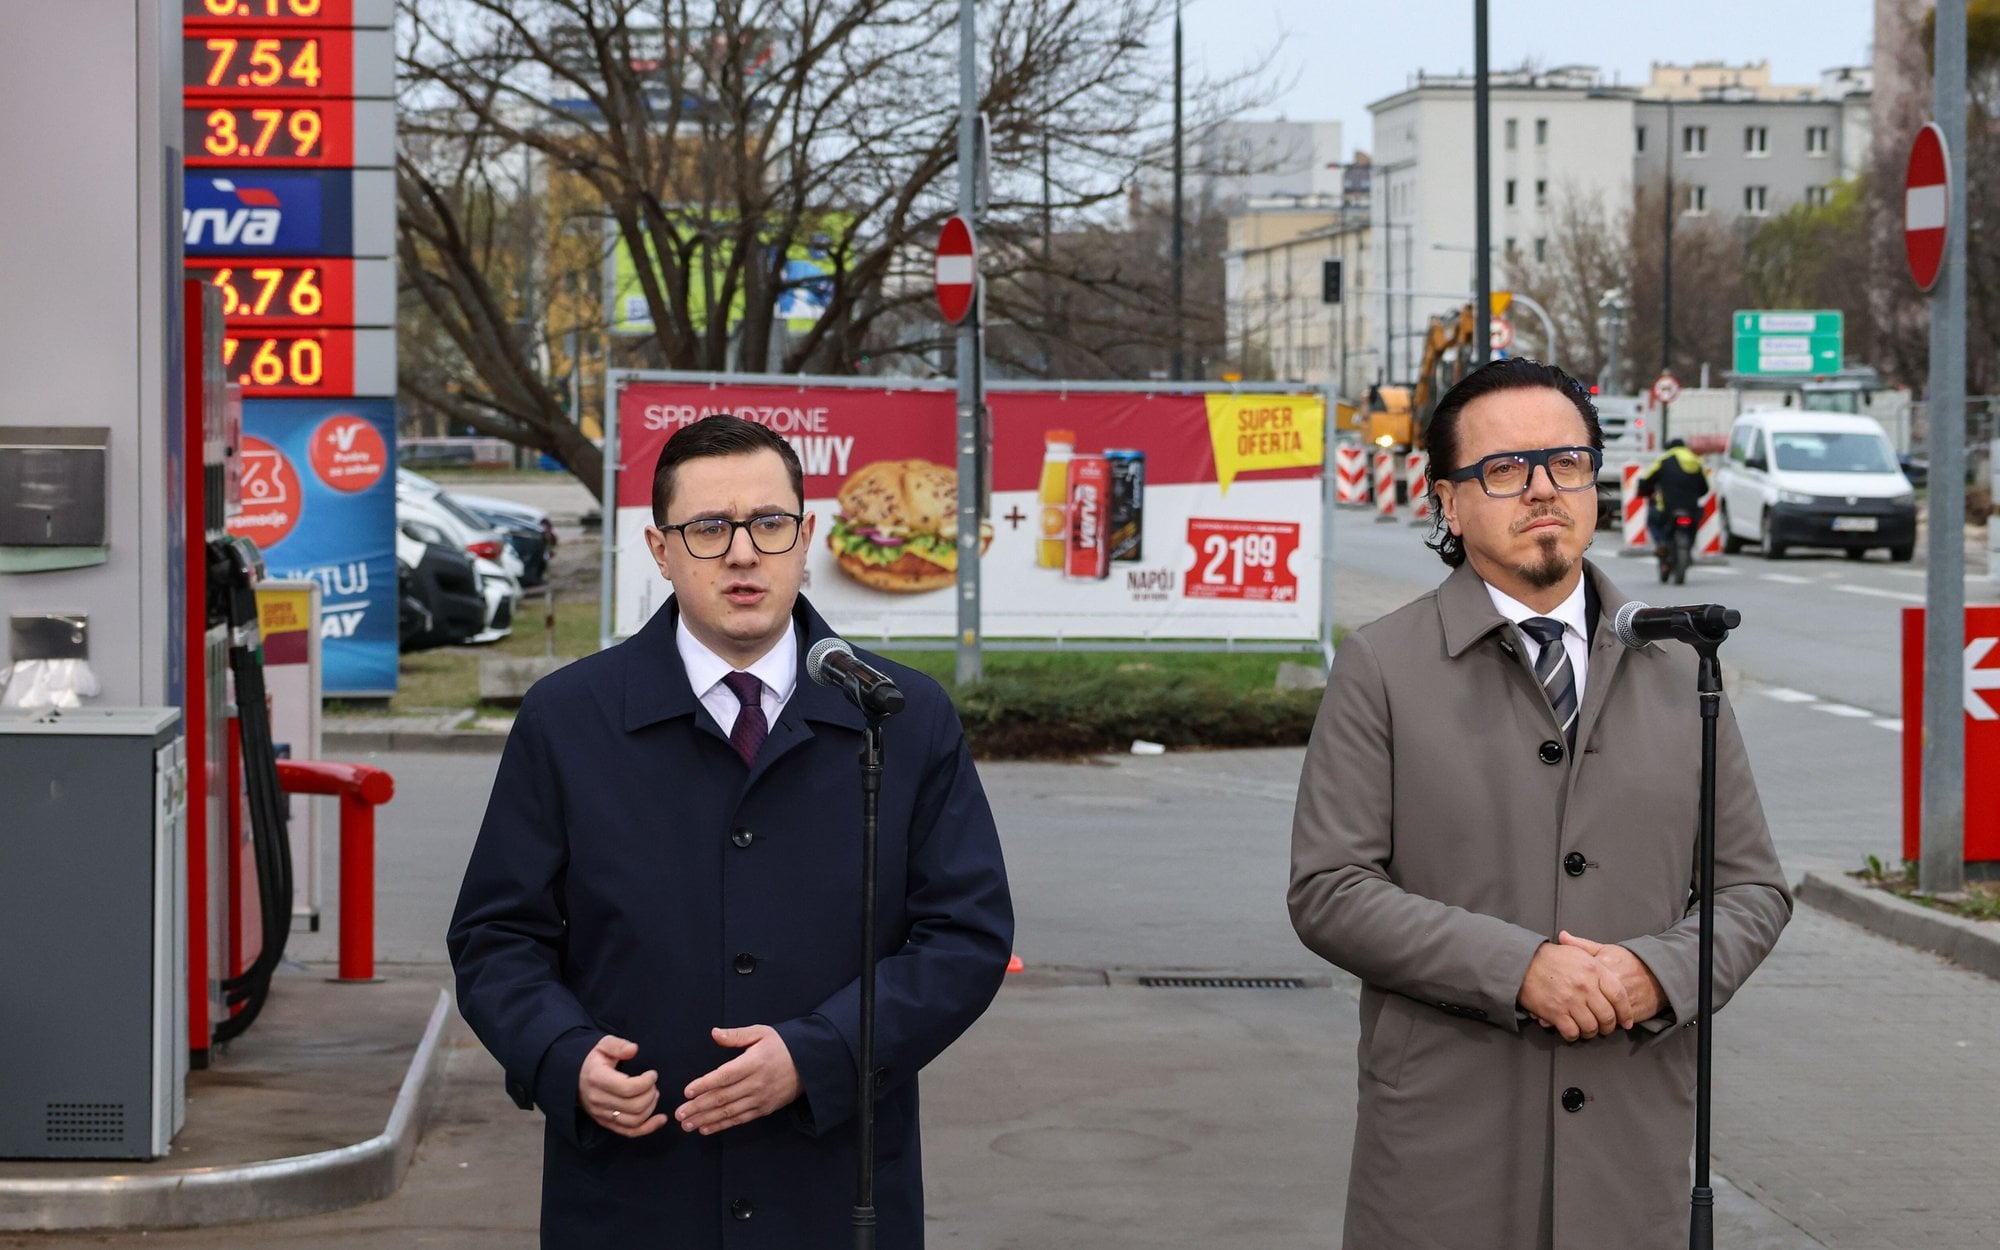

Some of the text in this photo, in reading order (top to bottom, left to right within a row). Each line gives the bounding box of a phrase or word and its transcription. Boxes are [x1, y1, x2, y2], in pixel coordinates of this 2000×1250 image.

[205, 39, 321, 86] 7.54
[205, 109, 321, 156] 3.79
[184, 208, 282, 245] rva
[1238, 406, 1293, 431] SUPER
[784, 435, 854, 476] AWY
[1238, 431, 1302, 457] OFERTA
[1127, 567, 1175, 591] NAPÓJ
[321, 611, 365, 639] AY
